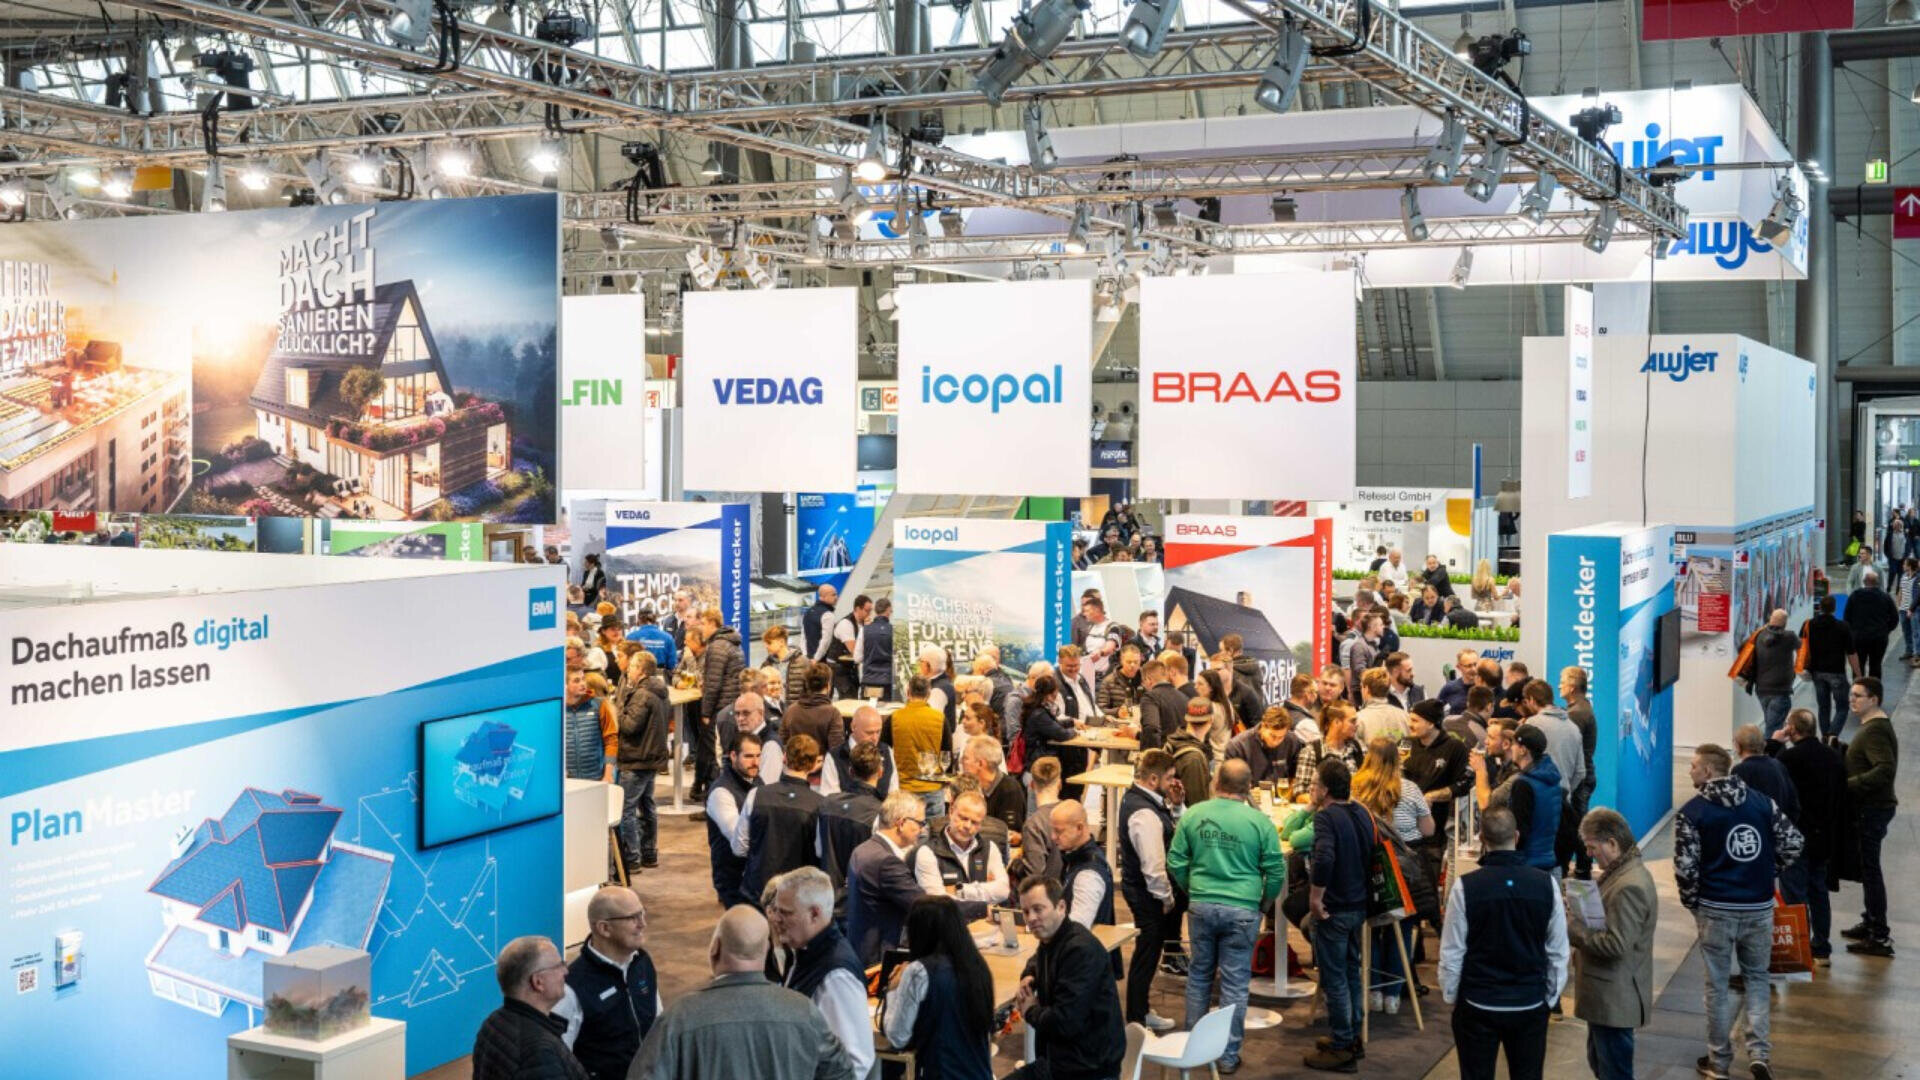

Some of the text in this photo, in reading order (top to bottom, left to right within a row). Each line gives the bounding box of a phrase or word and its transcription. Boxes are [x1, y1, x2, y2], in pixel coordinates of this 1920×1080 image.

[279, 207, 377, 277] MACHT
[279, 247, 376, 311] DACH
[278, 302, 376, 333] SANIEREN
[276, 332, 377, 356] GLÜCKLICH?
[712, 377, 823, 405] VEDAG
[922, 364, 1063, 413] icopal
[1152, 370, 1341, 403] BRAAS
[1358, 490, 1432, 501] Retesol GmbH
[615, 510, 650, 520] VEDAG
[1364, 506, 1430, 522] retesol
[905, 525, 958, 544] icopal
[1176, 523, 1237, 537] BRAAS
[616, 573, 680, 600] TEMPO
[532, 600, 554, 616] BMI
[907, 592, 969, 616] DÄCHER
[1054, 540, 1065, 667] entdecker
[11, 614, 268, 665] Dachaufmaß digital
[908, 620, 993, 642] FÜR NEUE
[1573, 555, 1595, 700] entdecker
[11, 662, 210, 705] machen lassen
